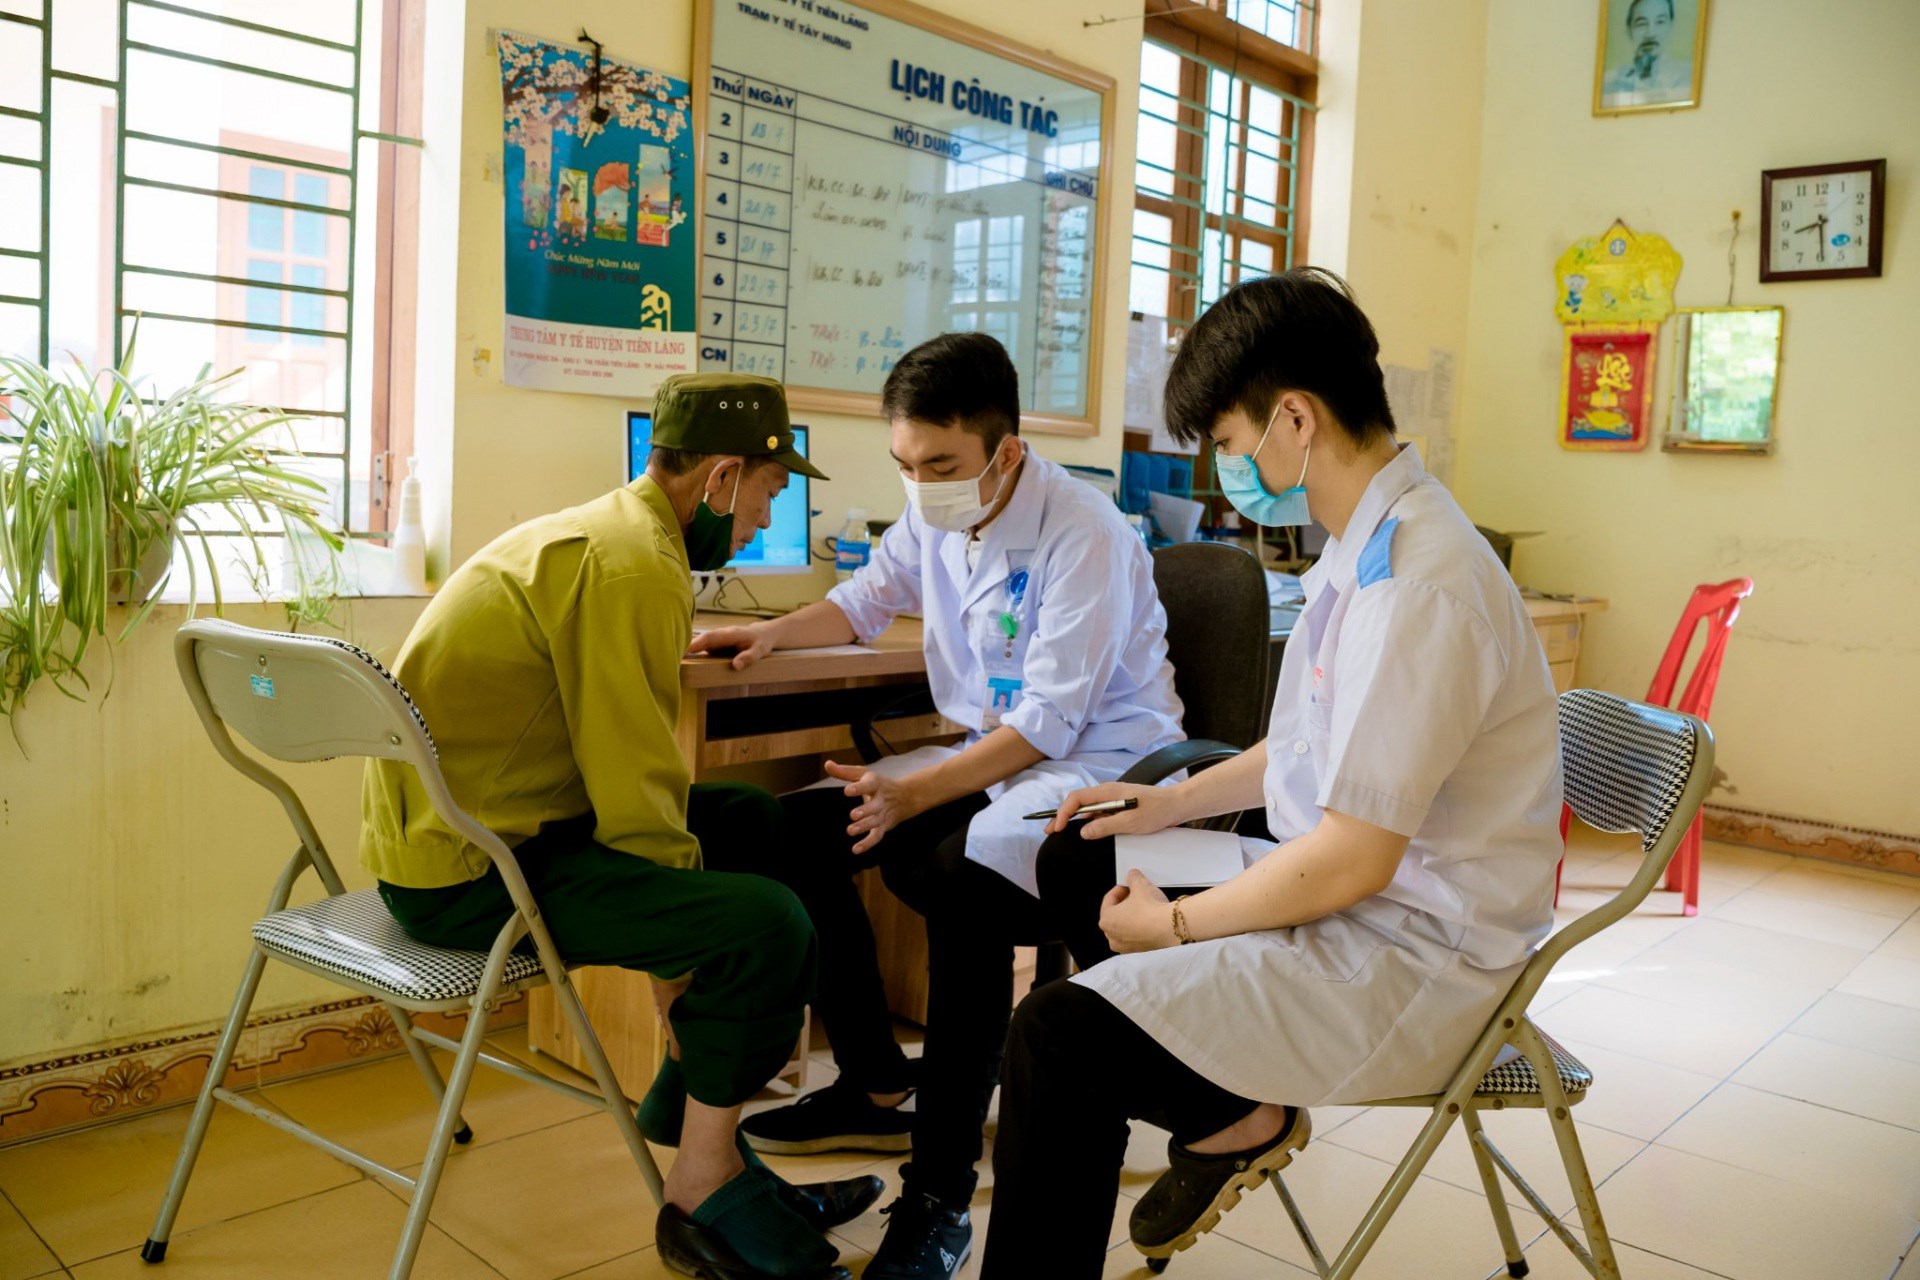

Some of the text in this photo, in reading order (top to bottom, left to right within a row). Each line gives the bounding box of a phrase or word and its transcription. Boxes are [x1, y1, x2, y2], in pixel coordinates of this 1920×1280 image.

[738, 2, 770, 22] TRẠM
[772, 14, 780, 25] Y
[783, 17, 797, 31] TẾ
[798, 23, 819, 39] TÂY
[712, 76, 742, 95] Thứ
[748, 86, 795, 109] NGÀY
[891, 58, 1059, 139] LỊCH CÔNG TÁC
[720, 112, 732, 127] 2
[893, 124, 963, 157] NỘI DUNG
[719, 151, 730, 165] 3
[1068, 176, 1095, 198] CHÚ
[1796, 184, 1807, 197] 11
[1815, 182, 1830, 196] 12
[716, 192, 728, 205] 4
[1780, 200, 1793, 213] 10
[1781, 219, 1791, 232] 9
[716, 231, 727, 246] 5
[596, 257, 619, 269] Năm
[1795, 251, 1804, 264] 7
[713, 272, 725, 287] 6
[712, 312, 723, 326] 7
[537, 327, 557, 346] TÂM
[559, 333, 567, 347] Y
[569, 329, 584, 348] TẾ
[700, 346, 727, 362] CN
